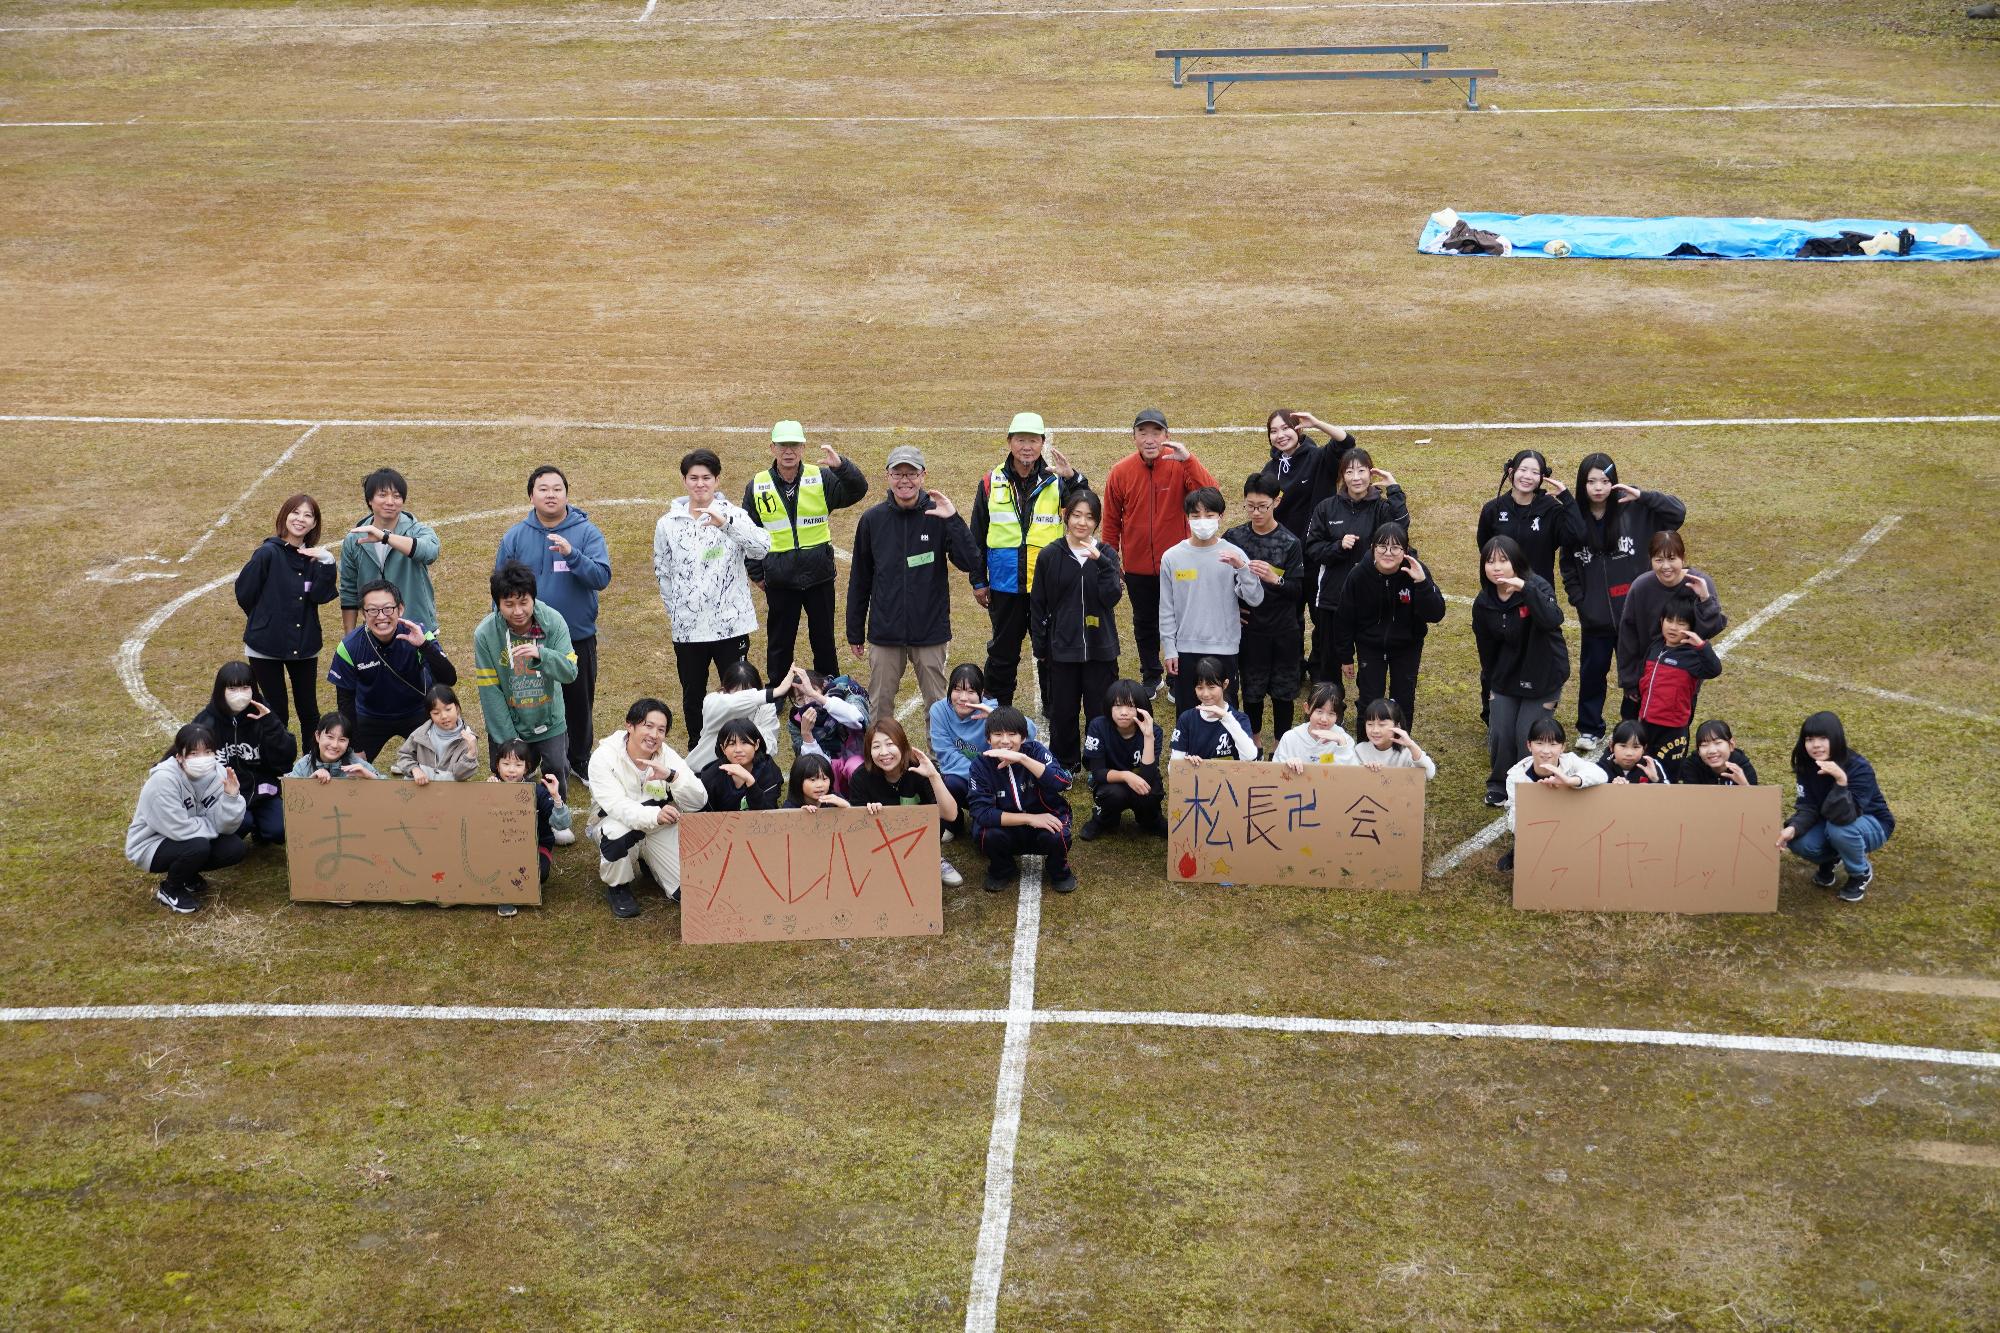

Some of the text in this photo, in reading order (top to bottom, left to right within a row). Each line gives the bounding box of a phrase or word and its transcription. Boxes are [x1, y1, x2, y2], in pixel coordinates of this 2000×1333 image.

[803, 517, 825, 525] PATROL
[309, 805, 502, 886] まさし
[706, 818, 928, 911] ハレルヤ
